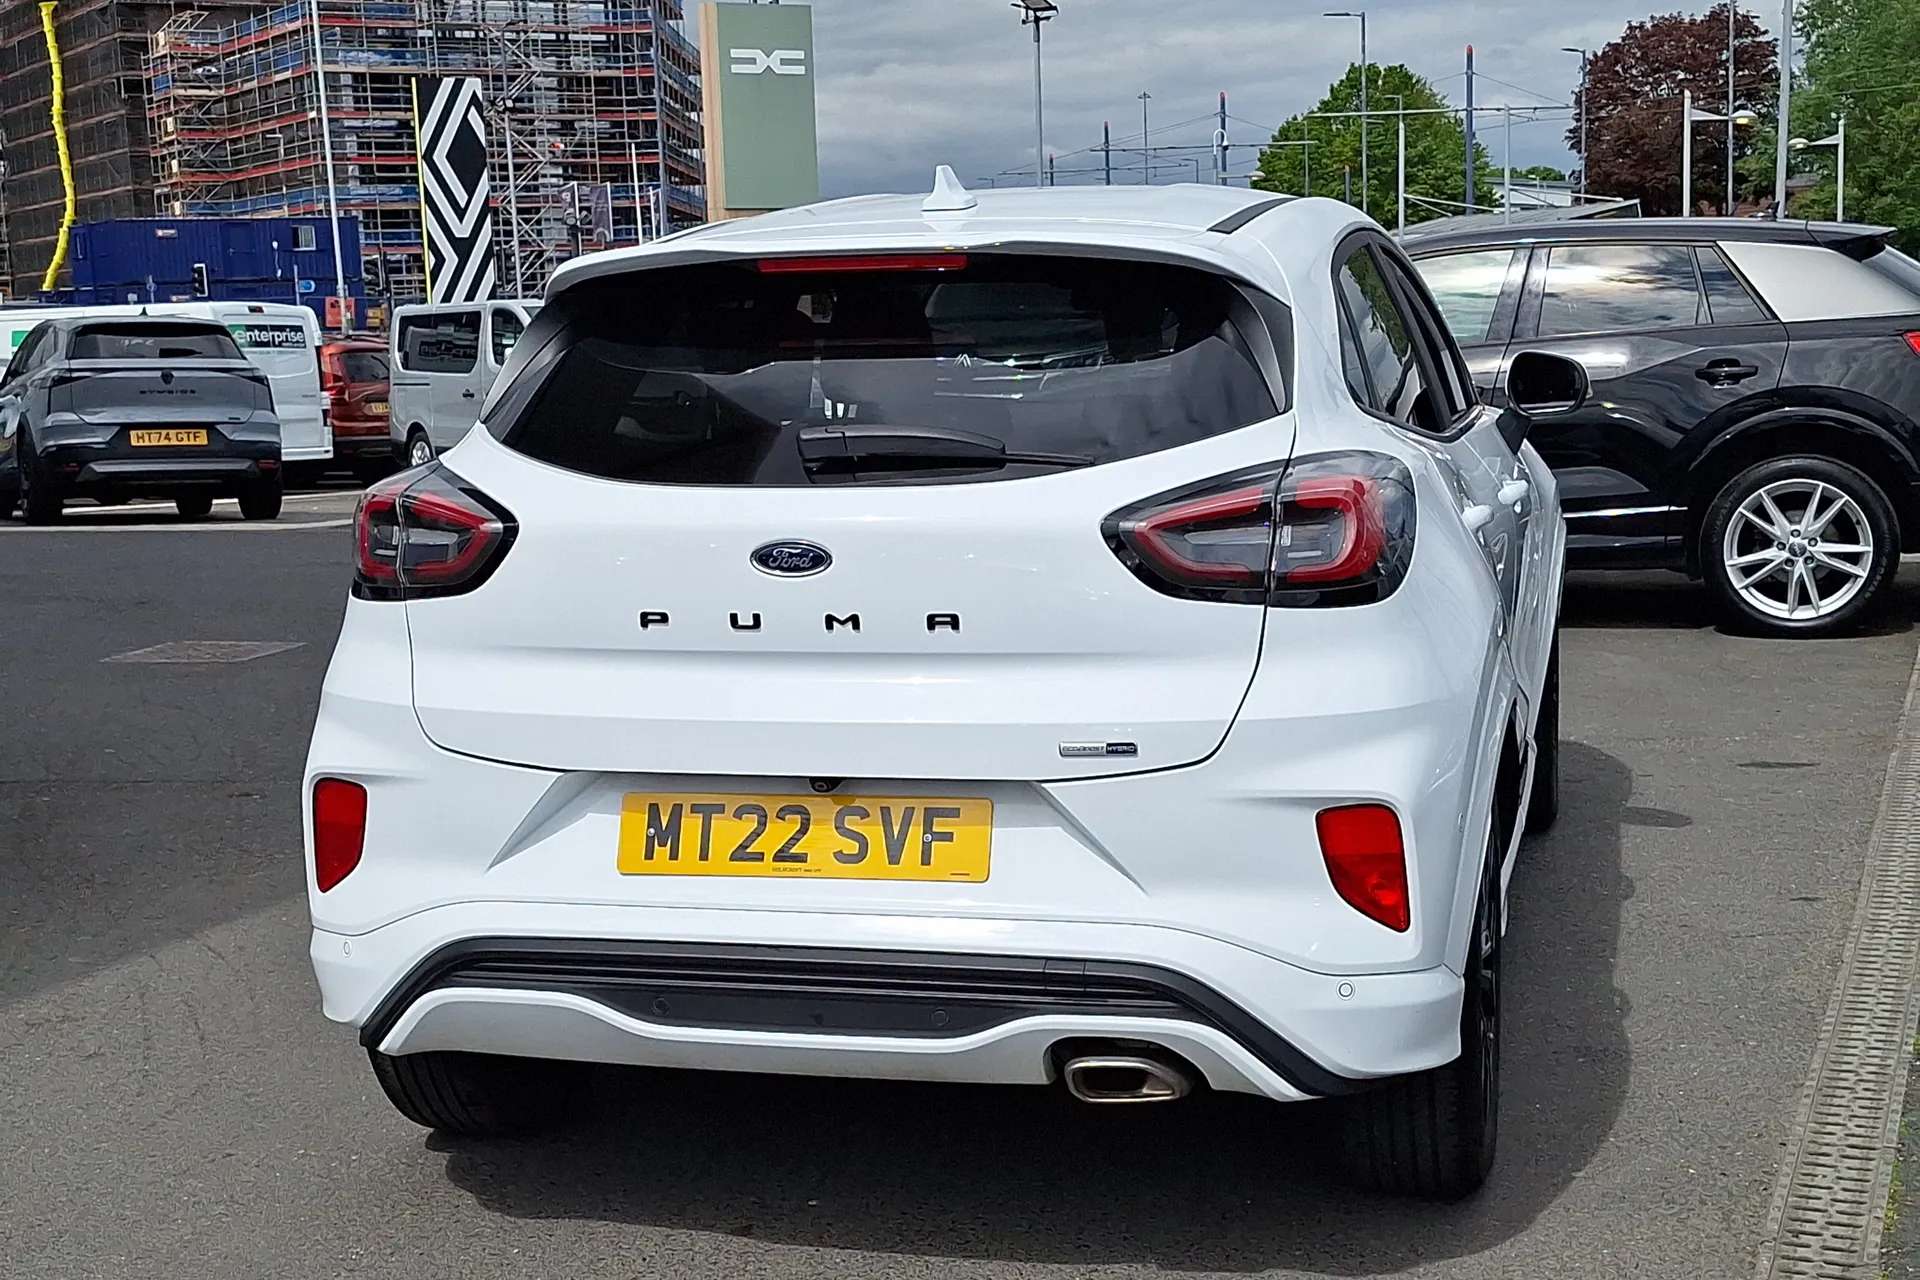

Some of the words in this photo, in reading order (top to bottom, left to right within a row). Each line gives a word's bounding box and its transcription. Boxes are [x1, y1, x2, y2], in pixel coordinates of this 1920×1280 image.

[234, 328, 305, 345] enterprise
[135, 431, 172, 443] HT74
[175, 431, 201, 443] GTF
[768, 547, 815, 569] Ford
[639, 610, 961, 634] PUMA
[643, 802, 812, 864] MT22
[831, 803, 961, 867] SVF
